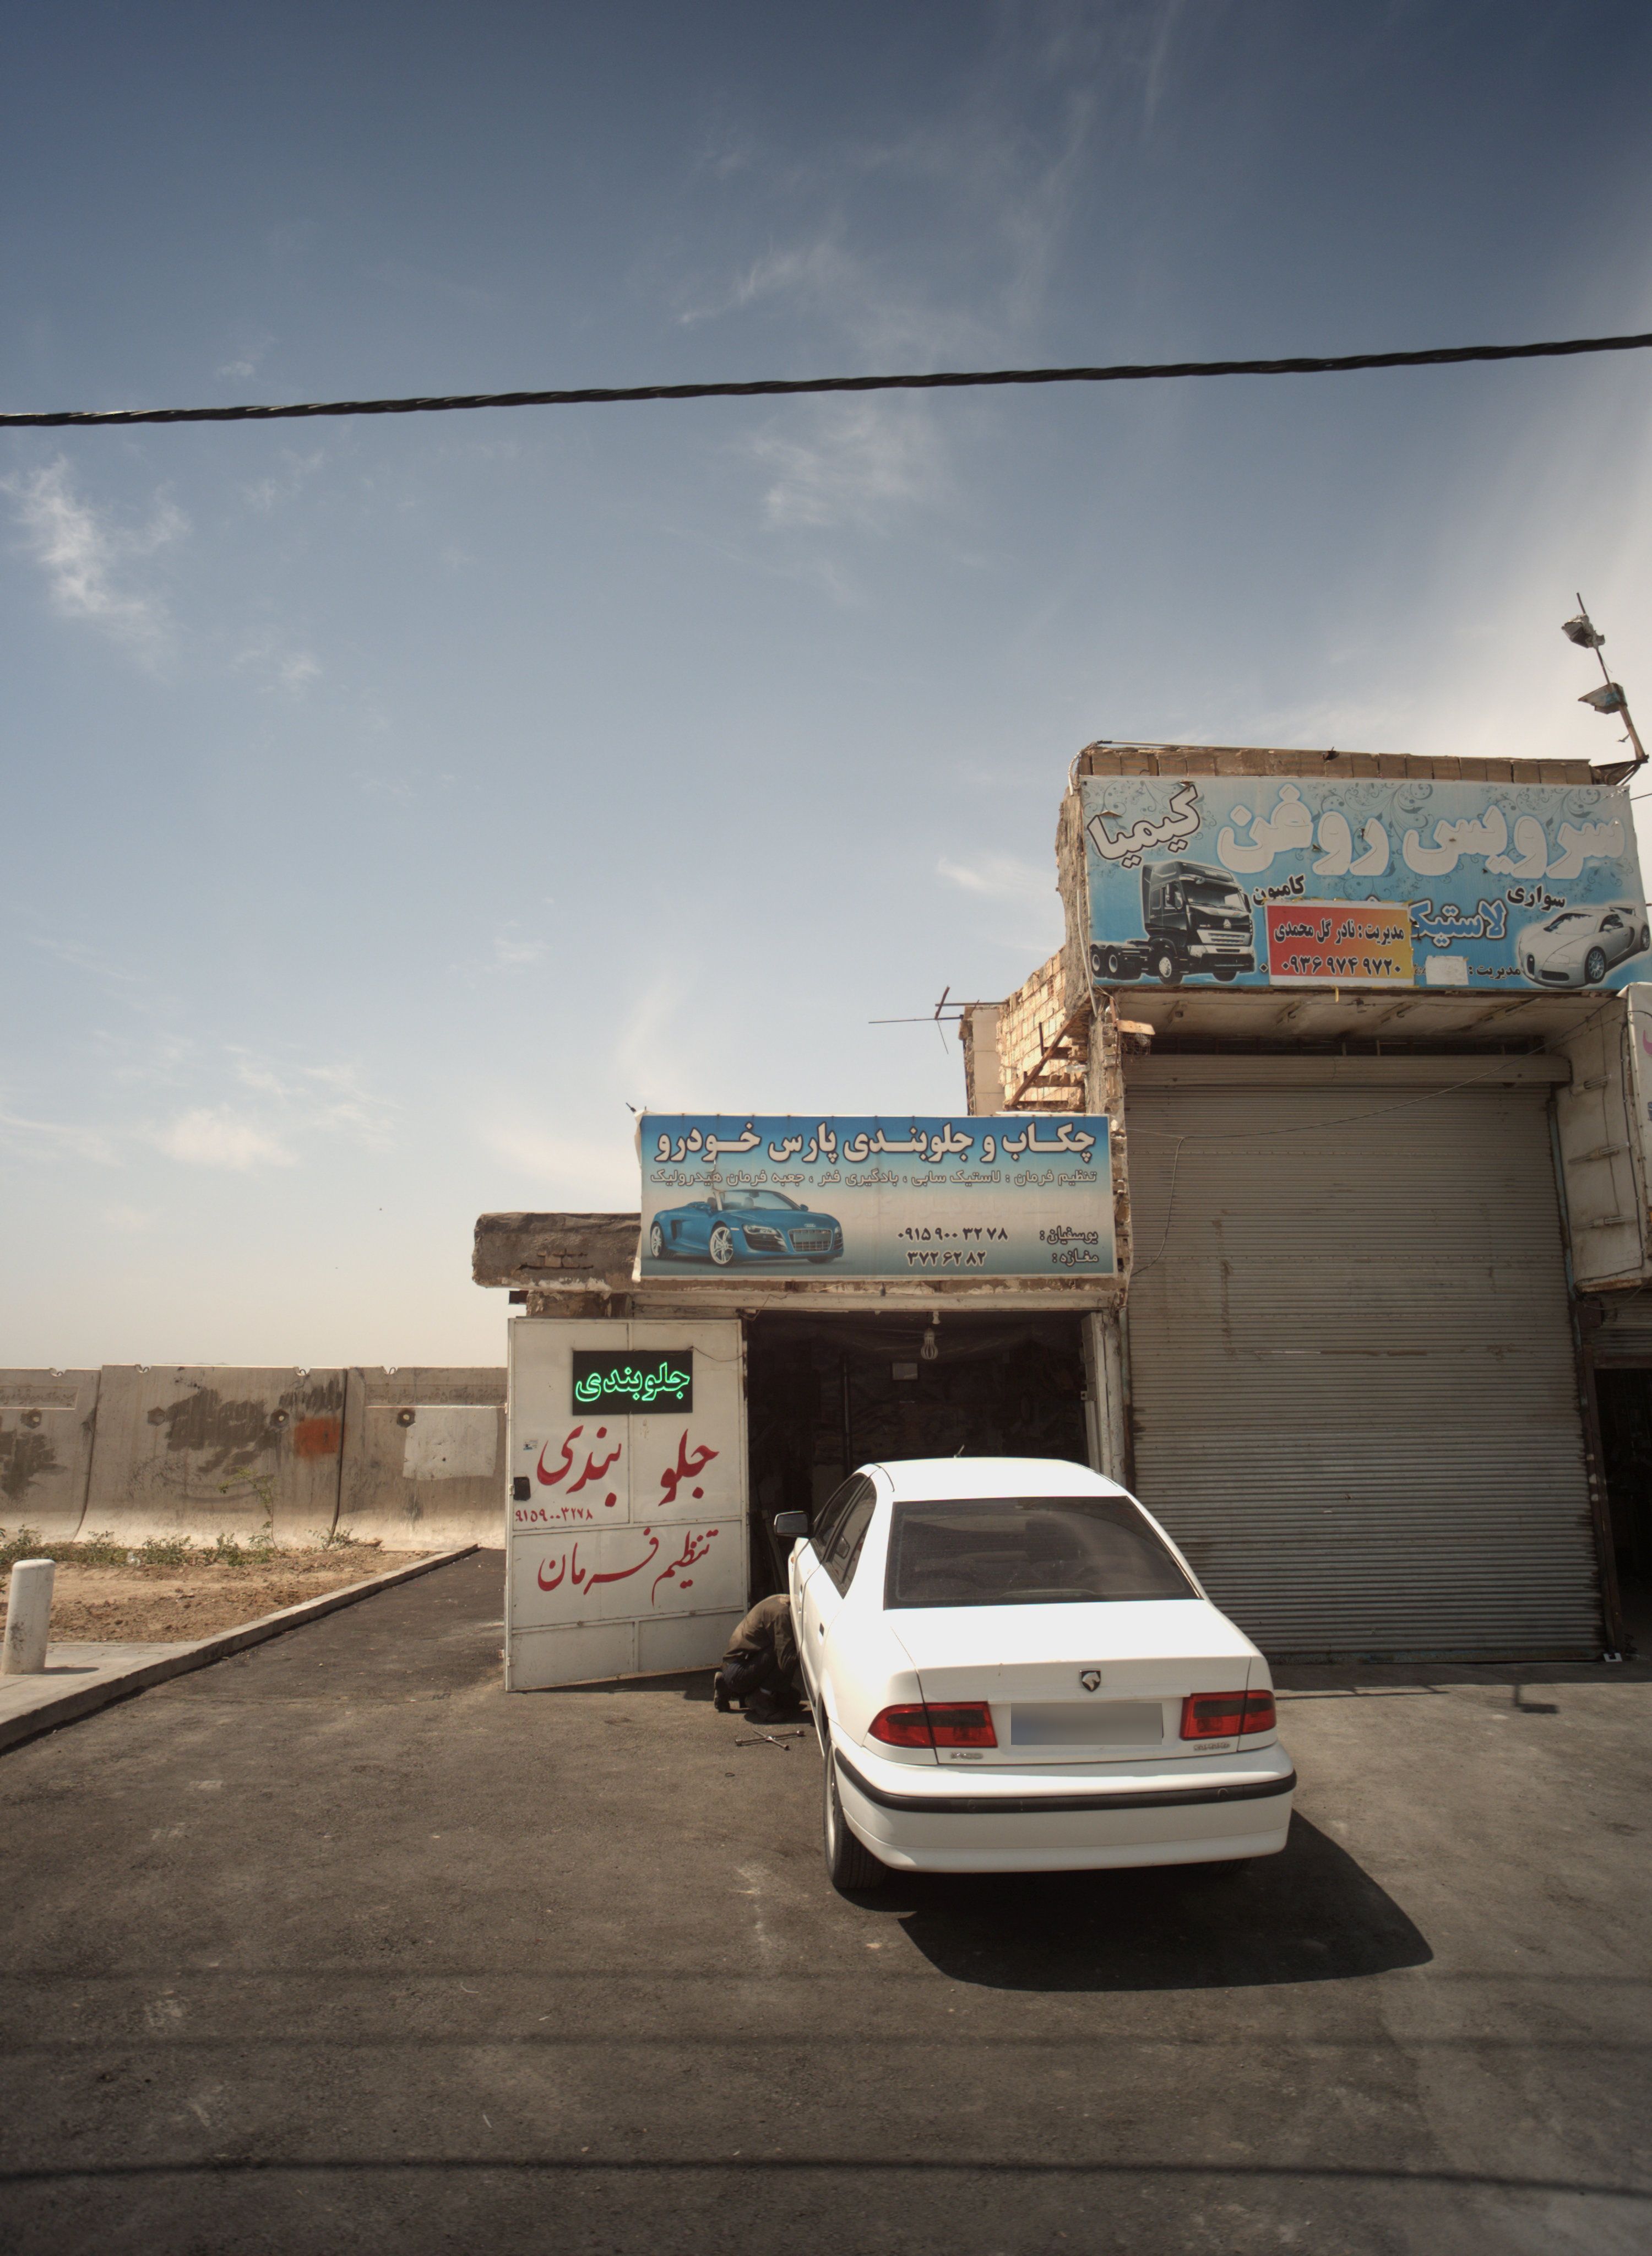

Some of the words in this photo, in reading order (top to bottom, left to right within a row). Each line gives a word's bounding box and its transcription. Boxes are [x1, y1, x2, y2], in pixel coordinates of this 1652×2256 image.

[1087, 784, 1200, 869] کیمیا
[1217, 784, 1389, 876] روغن
[1403, 805, 1625, 879] سرویس
[1507, 885, 1565, 910] سواری
[1274, 921, 1314, 943] محمدی
[1317, 918, 1332, 943] گل
[1335, 919, 1355, 944] نادر
[1282, 955, 1322, 974] ۰۹۳۶
[1326, 956, 1358, 975] ۹۷۴
[1362, 957, 1401, 976] ۹۷۲۰
[654, 1121, 762, 1162] خودرو
[768, 1121, 839, 1164] پارس
[843, 1121, 974, 1163] جلوبندی
[980, 1134, 996, 1163] و
[1002, 1121, 1096, 1163] چکاب
[650, 1169, 722, 1186] هیدرولیک
[727, 1169, 768, 1186] فرمان
[771, 1172, 805, 1186] جعبه
[845, 1169, 899, 1186] بادگیری
[950, 1169, 1001, 1186] لاستیک
[1058, 1170, 1097, 1186] تنظیم
[575, 1362, 691, 1402] جلوبندی
[537, 1425, 622, 1507] بندی
[658, 1428, 720, 1507] جلو
[537, 1527, 659, 1596] فرمان
[651, 1529, 719, 1607] تنظیم
